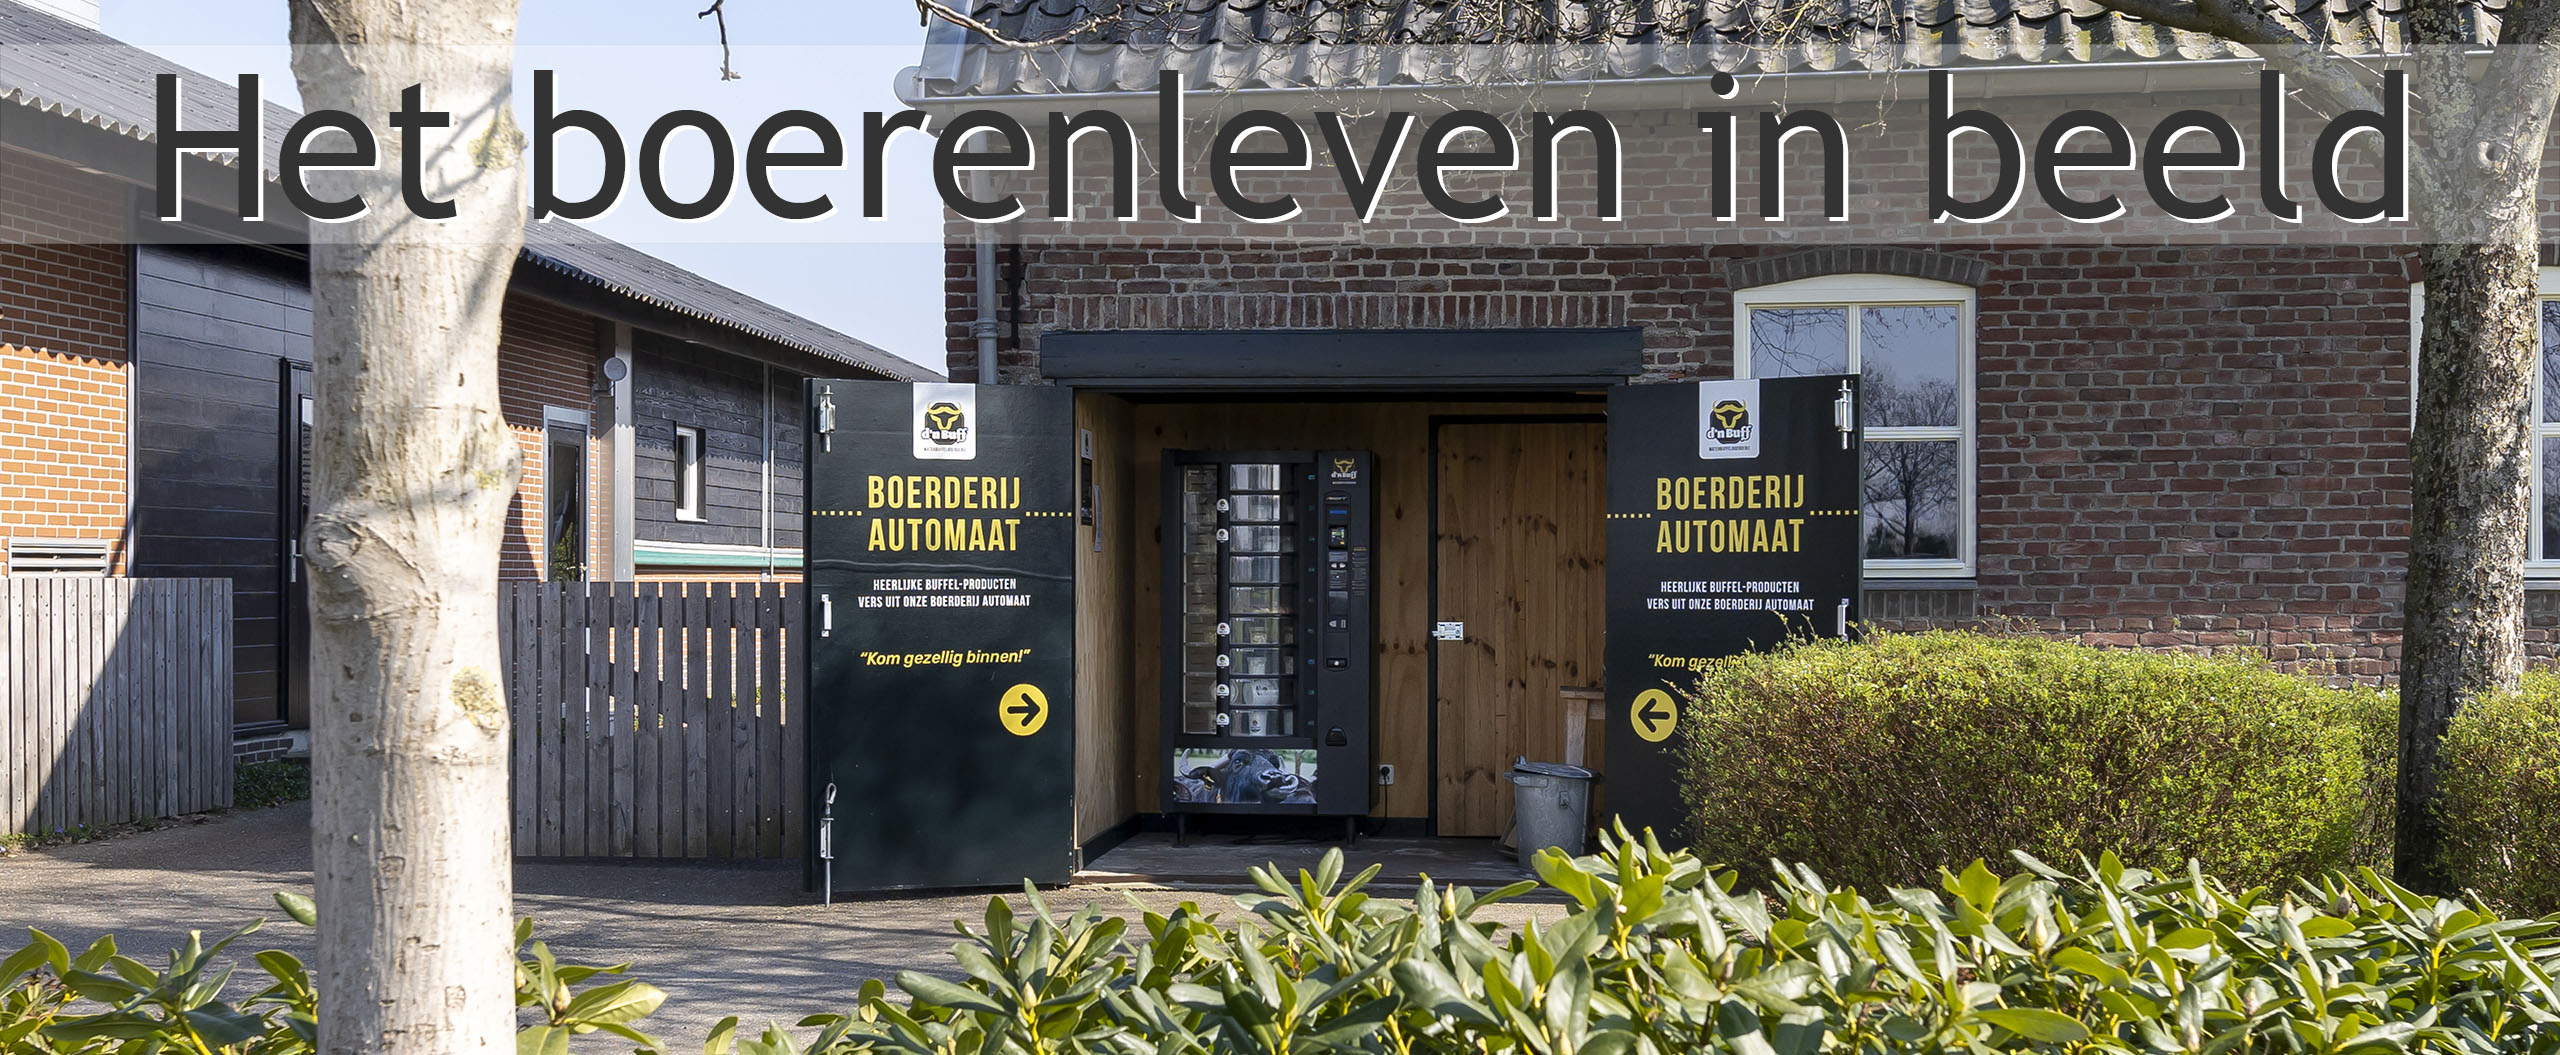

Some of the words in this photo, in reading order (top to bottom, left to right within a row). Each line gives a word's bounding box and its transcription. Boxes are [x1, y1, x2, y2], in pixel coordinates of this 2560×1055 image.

[868, 475, 1021, 509] BOERDERIJ
[1656, 474, 1804, 511] BOERDERIJ
[868, 518, 1021, 552] AUTOMAAT
[1656, 518, 1804, 554] AUTOMAAT
[873, 579, 923, 591] HEERLIJKE
[926, 578, 1017, 590] BUFFEL-PRODUCTEN
[1660, 581, 1707, 593] HEERLIJKE
[1710, 581, 1800, 593] BUFFEL-PRODUCTEN
[858, 596, 883, 608] VERS
[885, 596, 901, 608] UIT
[903, 596, 928, 608] ONZE
[930, 595, 979, 607] BOERDERIJ
[982, 594, 1031, 607] AUTOMAAT
[1647, 598, 1670, 610] VERS
[1671, 598, 1686, 610] UIT
[1688, 598, 1712, 610] ONZE
[1714, 598, 1762, 610] BOERDERIJ
[1765, 599, 1815, 611] AUTOMAAT
[903, 649, 963, 668] gezellig
